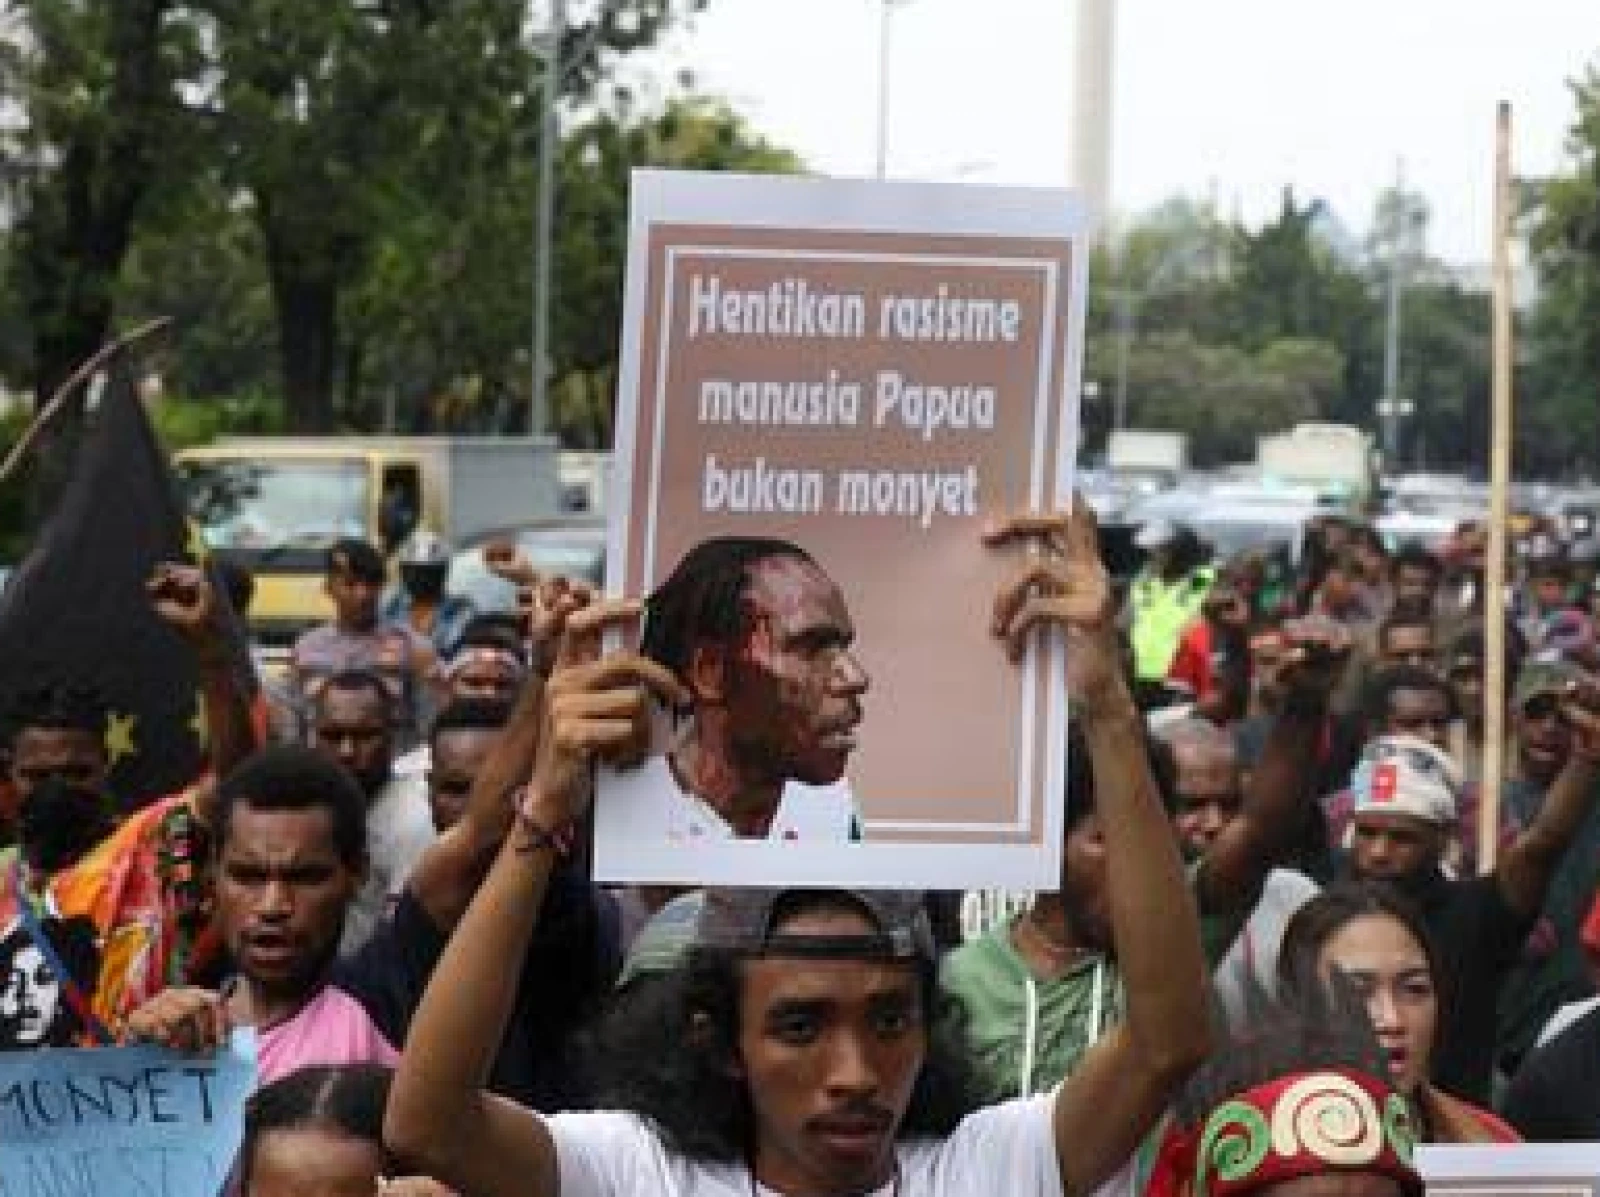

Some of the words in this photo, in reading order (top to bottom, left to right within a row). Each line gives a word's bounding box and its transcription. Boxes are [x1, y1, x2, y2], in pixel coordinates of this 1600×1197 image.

[688, 274, 865, 340] Hentikan
[880, 282, 1021, 341] rasisme
[698, 370, 860, 425] manusia
[873, 370, 995, 440] Papua
[702, 453, 823, 513] bukan
[837, 465, 979, 529] monyet
